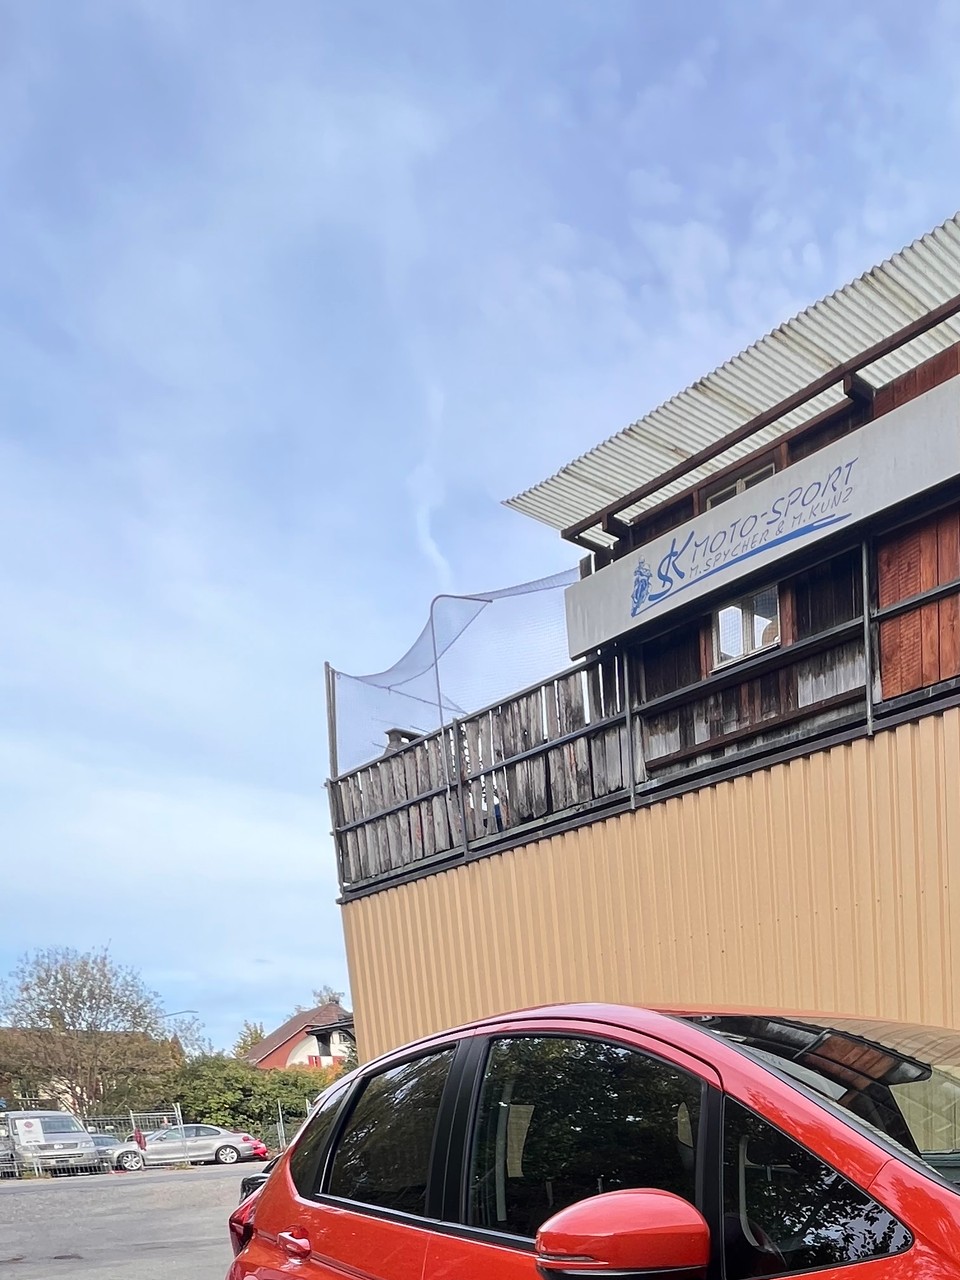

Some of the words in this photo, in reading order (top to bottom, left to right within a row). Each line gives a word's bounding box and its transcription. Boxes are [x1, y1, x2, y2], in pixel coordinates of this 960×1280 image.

[689, 528, 770, 579] M.SPYCHER
[775, 520, 785, 536] &
[692, 457, 859, 563] MOTO-SPORT
